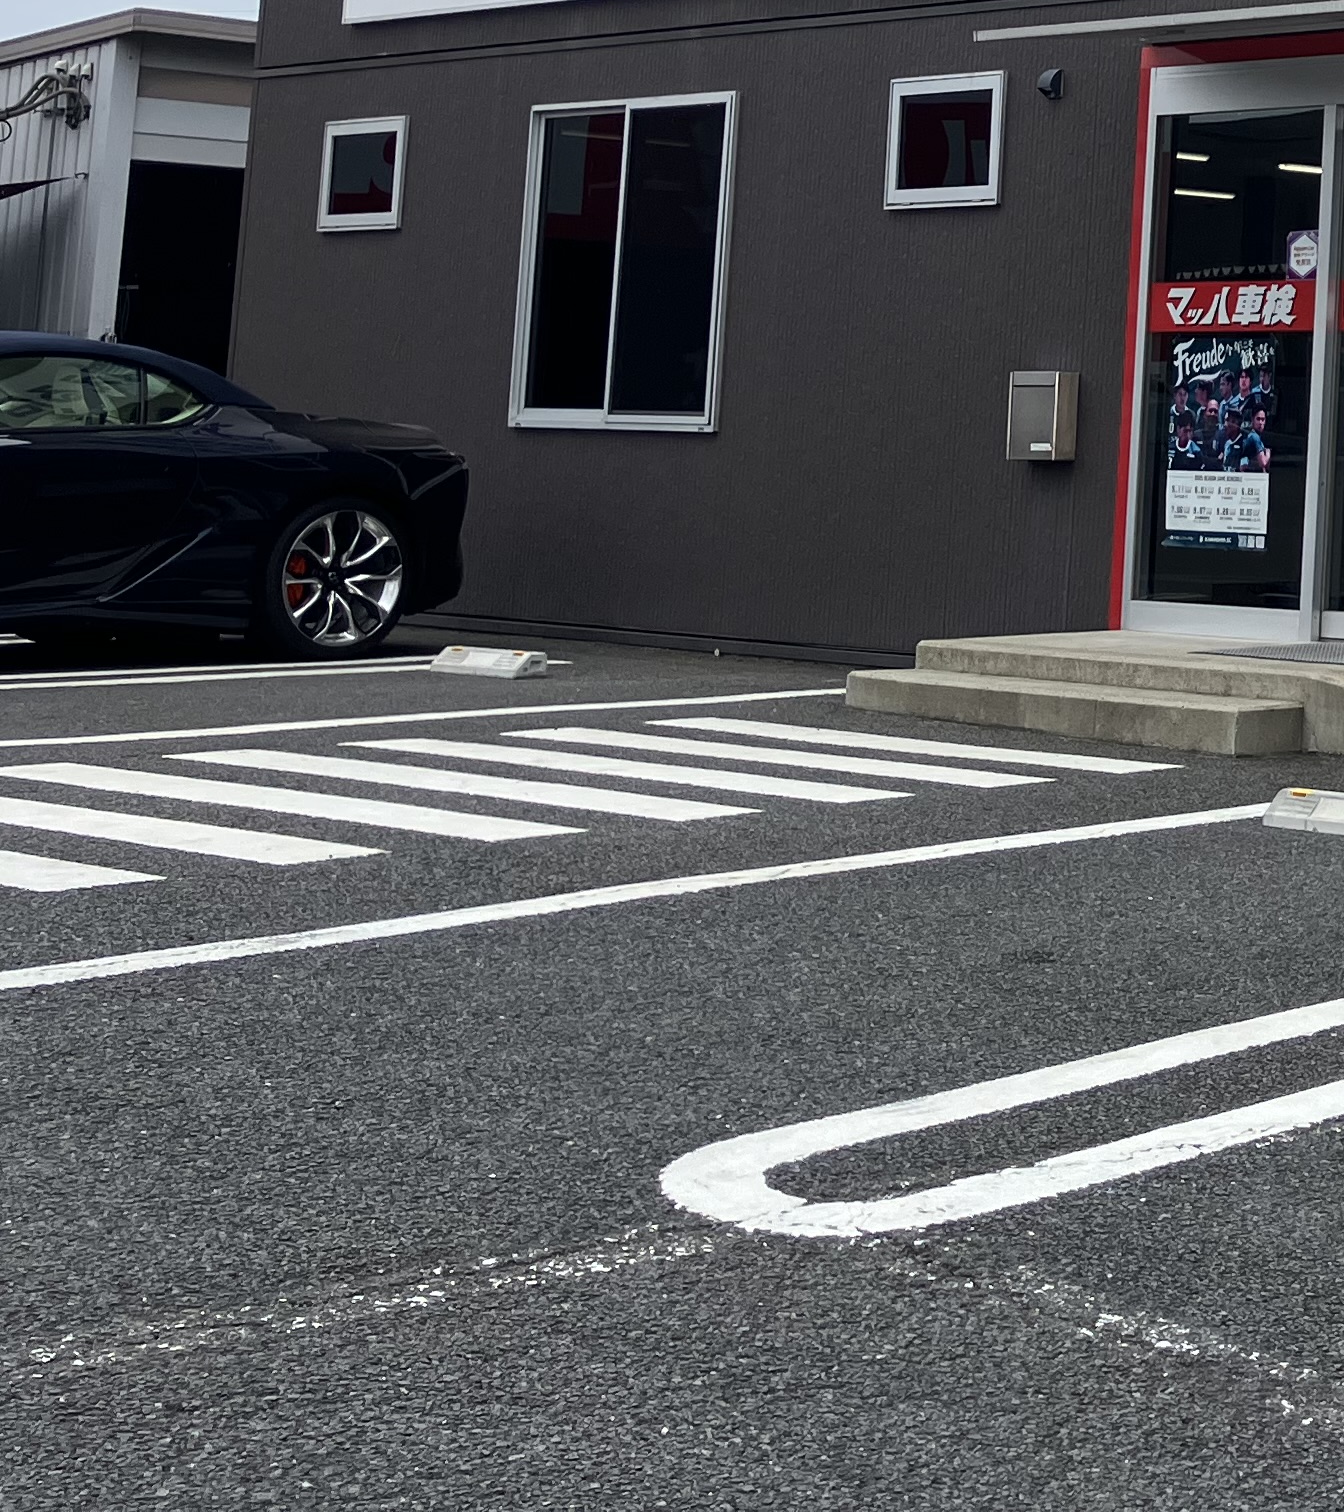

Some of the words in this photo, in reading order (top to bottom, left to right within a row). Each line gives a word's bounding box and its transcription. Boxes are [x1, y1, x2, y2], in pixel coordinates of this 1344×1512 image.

[1166, 284, 1297, 326] マッハ車検
[1173, 337, 1227, 387] Freude
